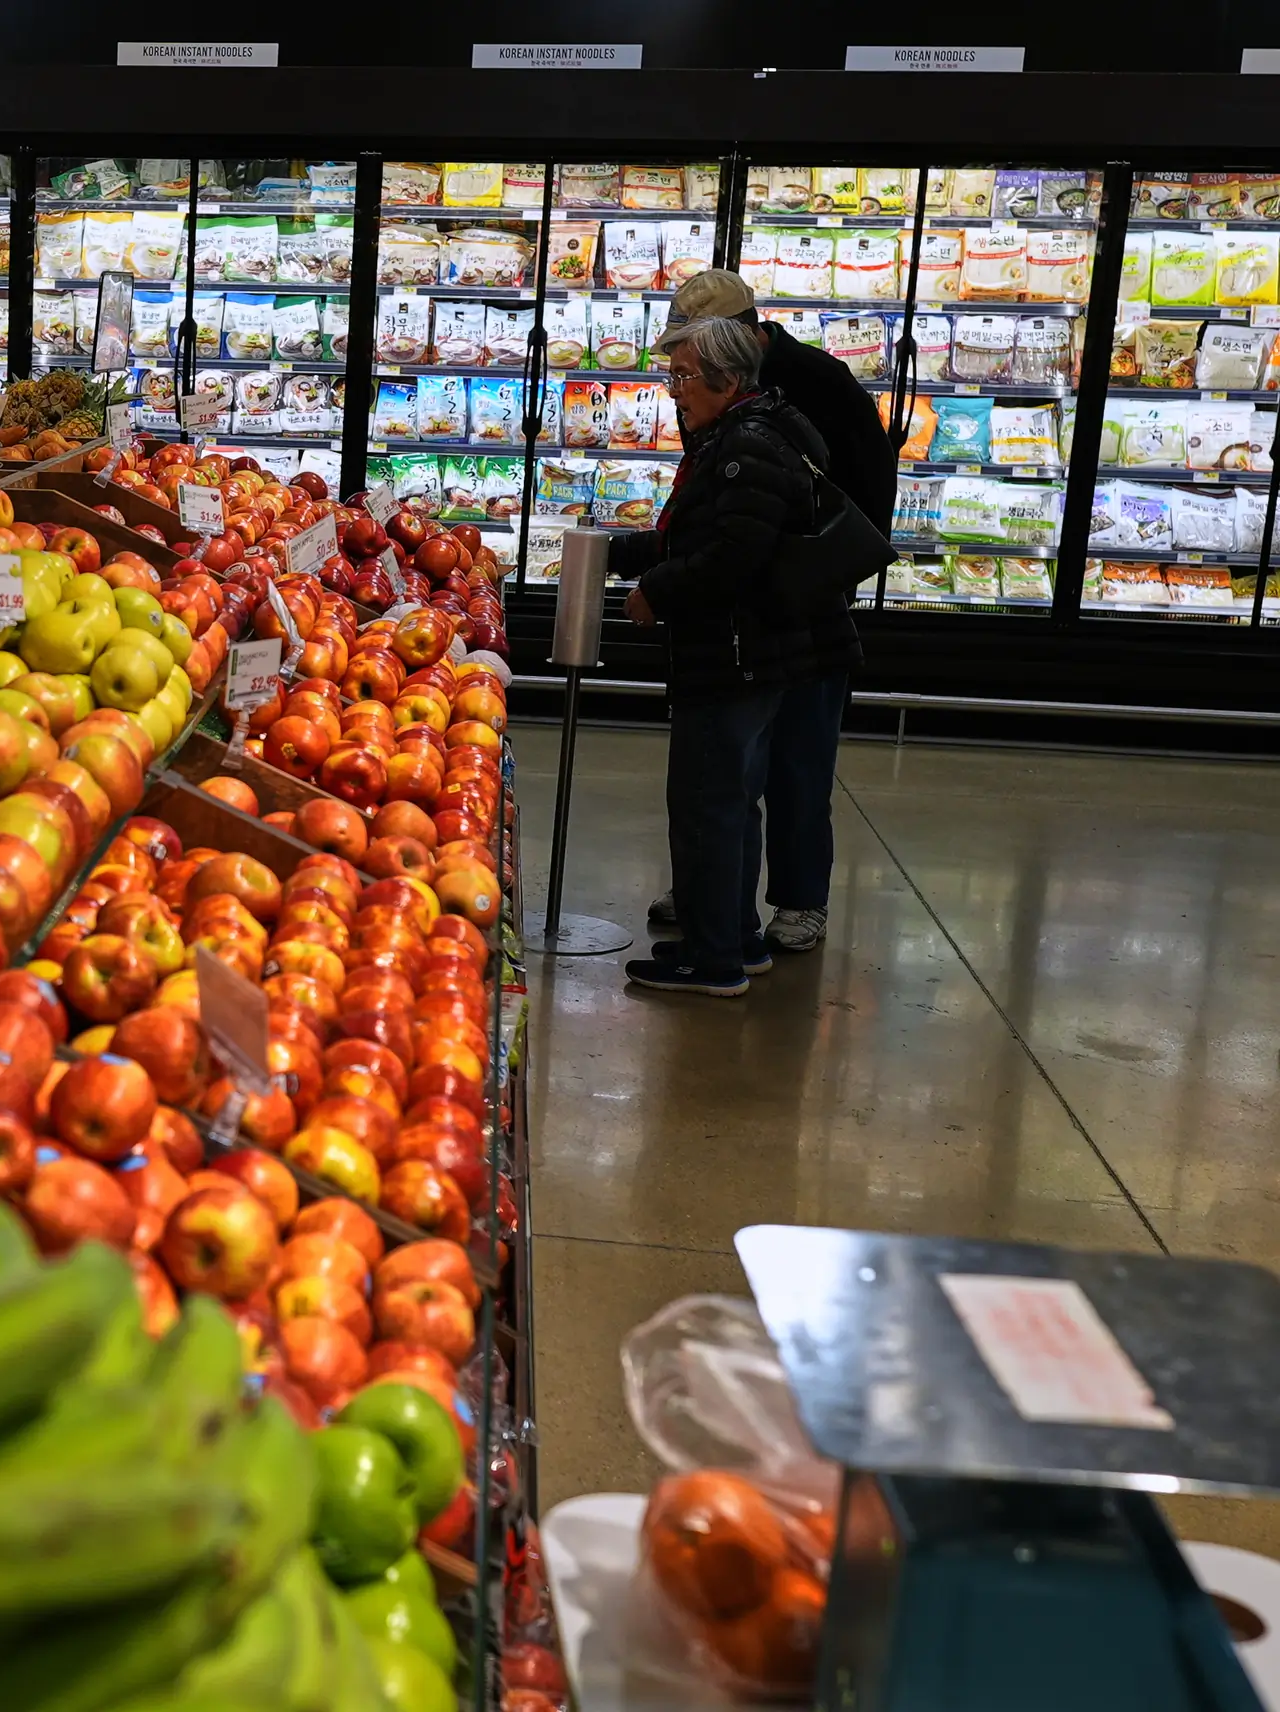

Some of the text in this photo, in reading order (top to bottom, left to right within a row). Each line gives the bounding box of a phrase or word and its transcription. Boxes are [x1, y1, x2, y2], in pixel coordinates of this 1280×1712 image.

[143, 46, 252, 57] KOREAN INSTANT NOODLES
[500, 48, 615, 59] KOREAN INSTANT NOODLES
[895, 50, 975, 61] KOREAN NOODLES
[1037, 242, 1077, 255] 생소면
[960, 331, 1013, 345] 생메밀국수
[1222, 342, 1252, 354] 생소면
[553, 485, 574, 498] PACK
[595, 475, 605, 498] 4
[606, 484, 628, 497] PACK
